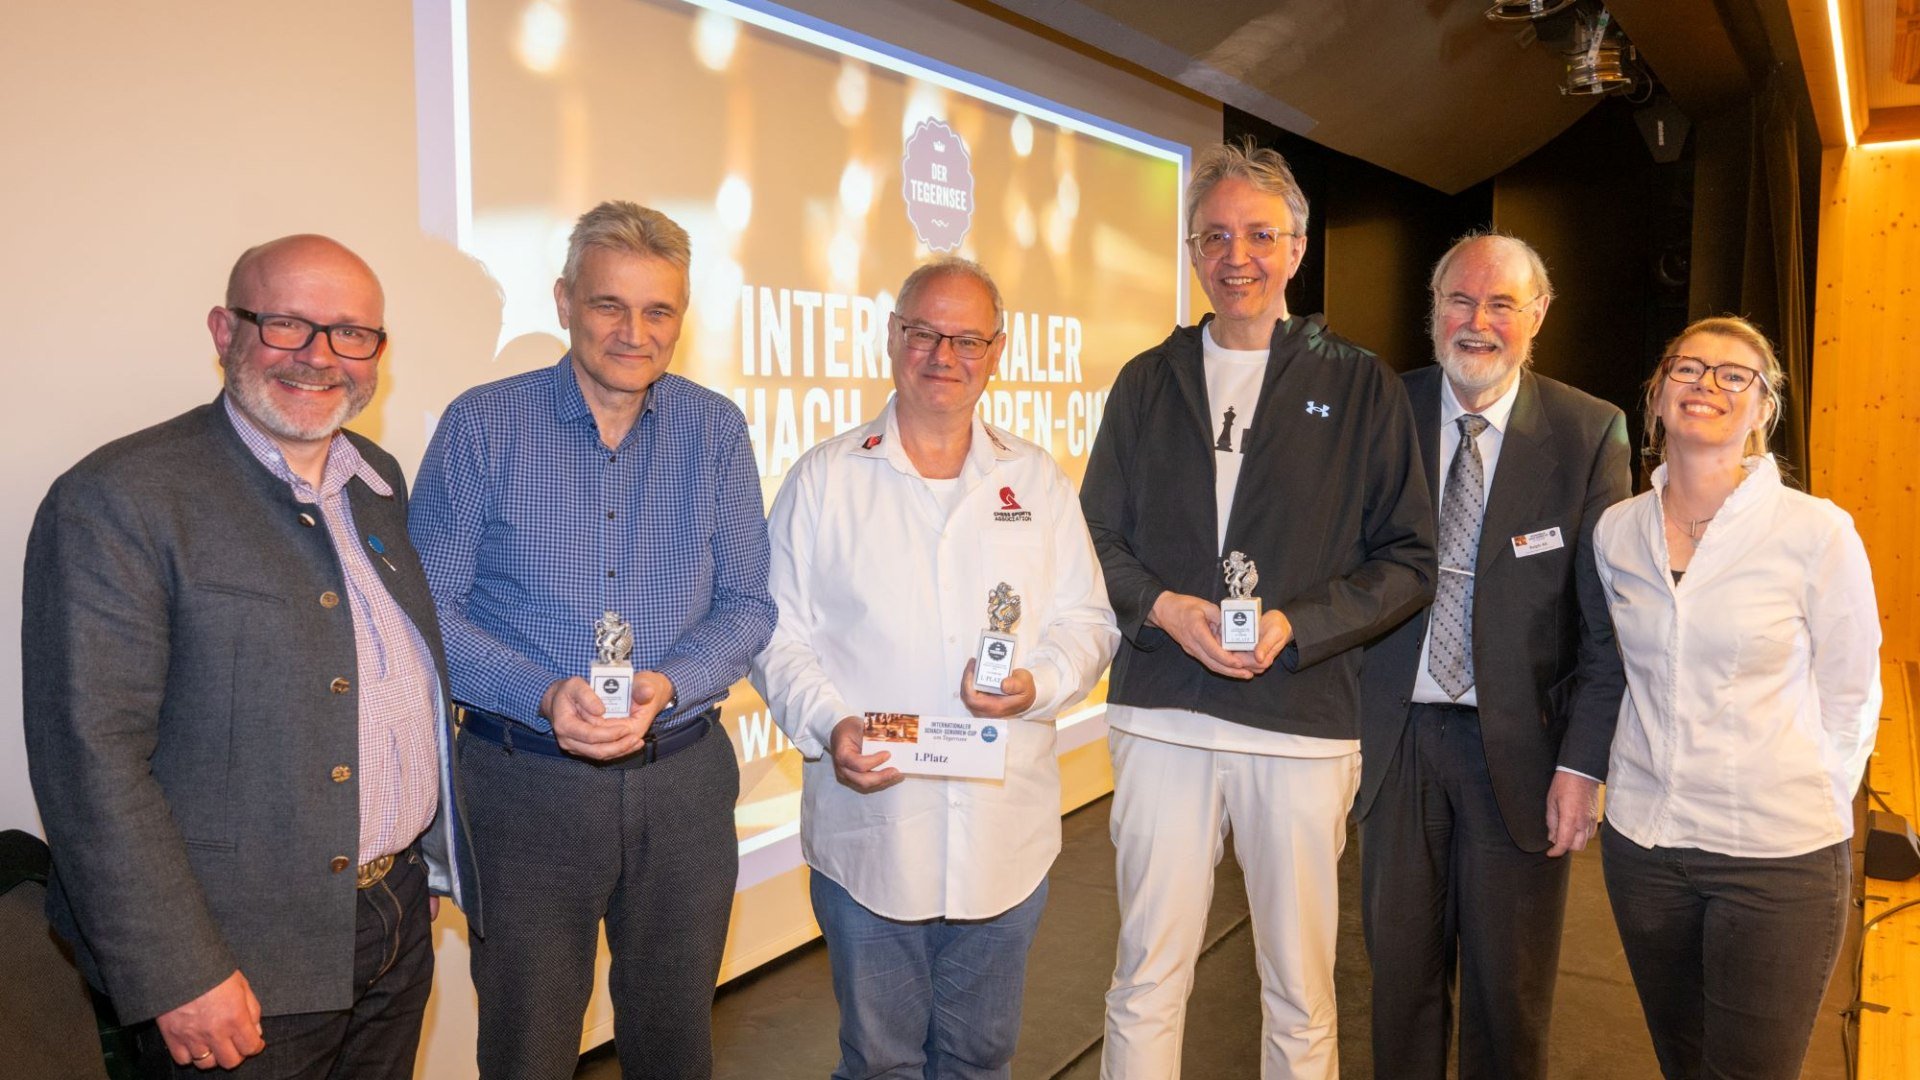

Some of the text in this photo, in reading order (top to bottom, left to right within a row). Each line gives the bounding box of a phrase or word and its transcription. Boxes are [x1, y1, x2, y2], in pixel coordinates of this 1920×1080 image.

[931, 162, 948, 183] DER
[910, 179, 967, 212] TEGERNSEE
[741, 284, 1083, 384] INTERALER
